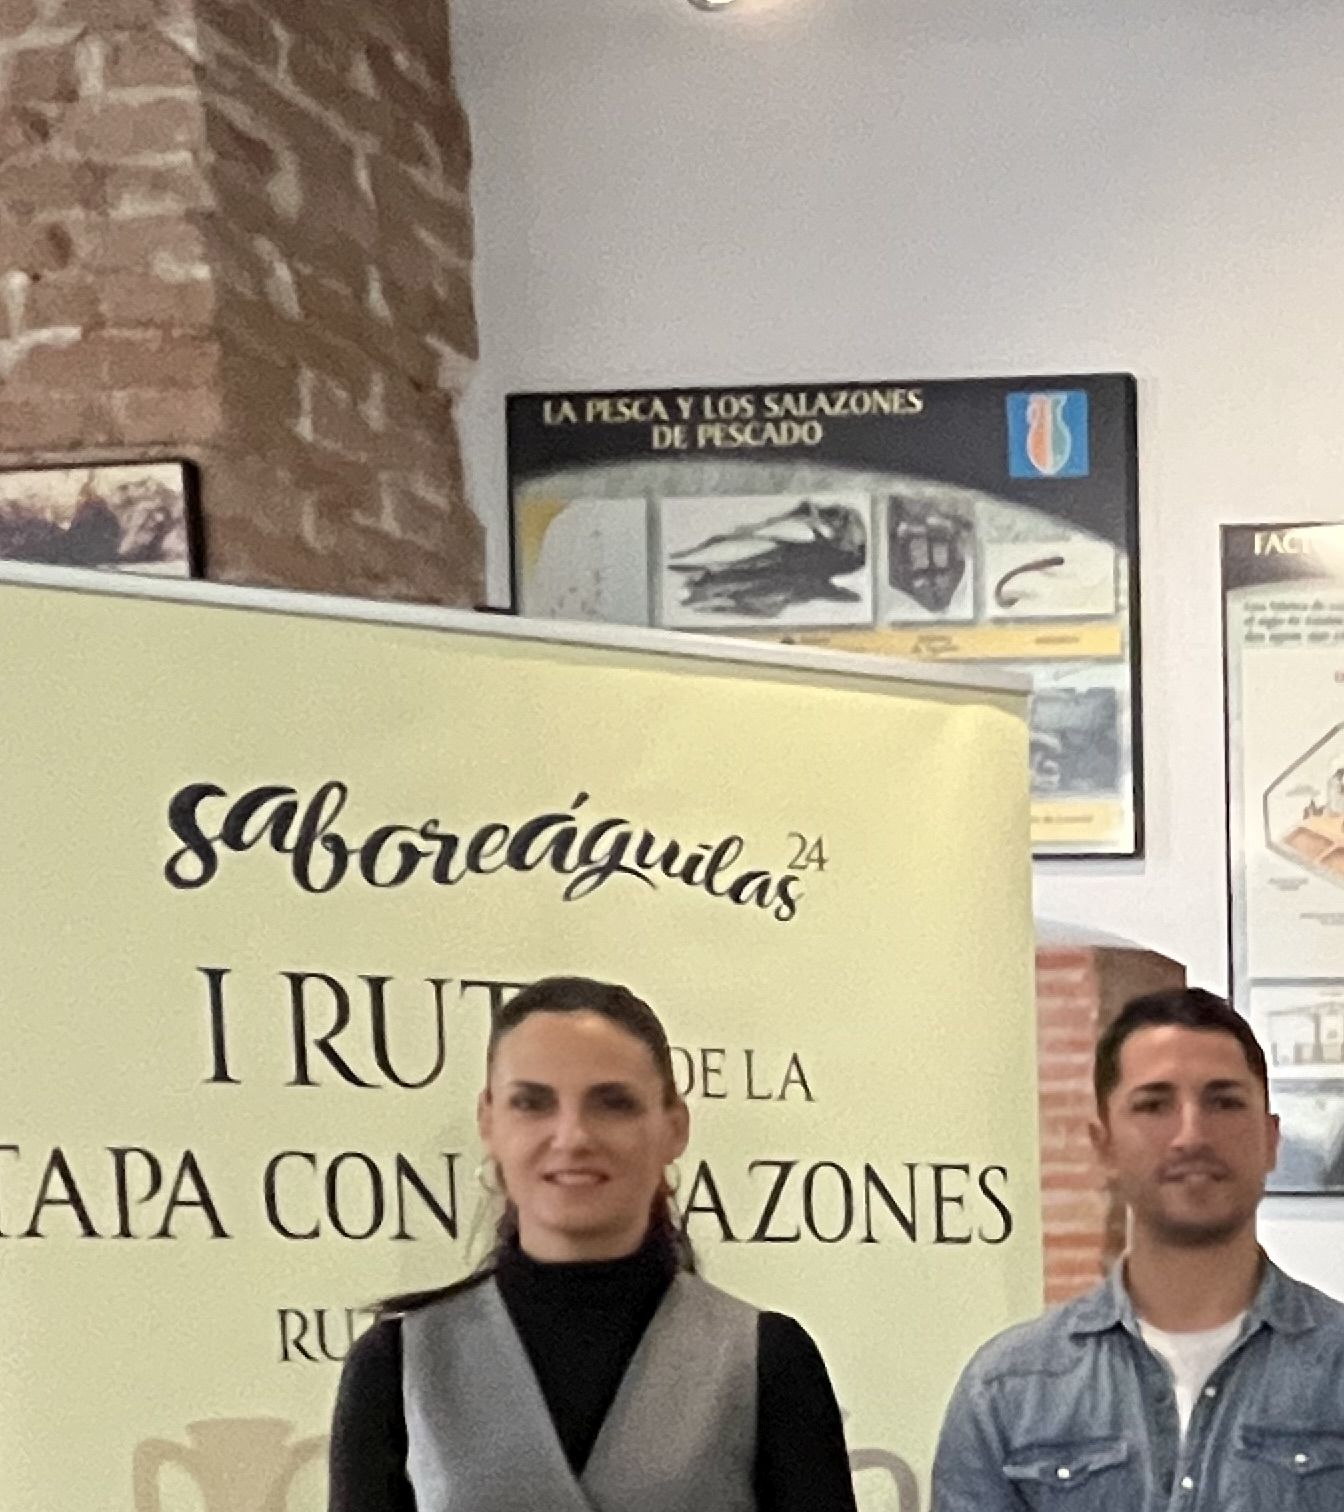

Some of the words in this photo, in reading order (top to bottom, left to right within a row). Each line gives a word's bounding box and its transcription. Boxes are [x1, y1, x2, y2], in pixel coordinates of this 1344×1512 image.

[543, 400, 578, 425] LA
[586, 399, 669, 423] PESCA
[677, 397, 693, 419] Y
[703, 394, 754, 419] LOS
[763, 389, 924, 417] SALAZONES
[652, 425, 687, 449] DE
[697, 420, 823, 448] PESCADO
[787, 833, 830, 872] 24
[196, 966, 243, 1084] I
[277, 970, 536, 1090] RUT
[743, 1048, 816, 1102] LA
[262, 1149, 464, 1242] CON
[680, 1158, 1014, 1245] AZONES
